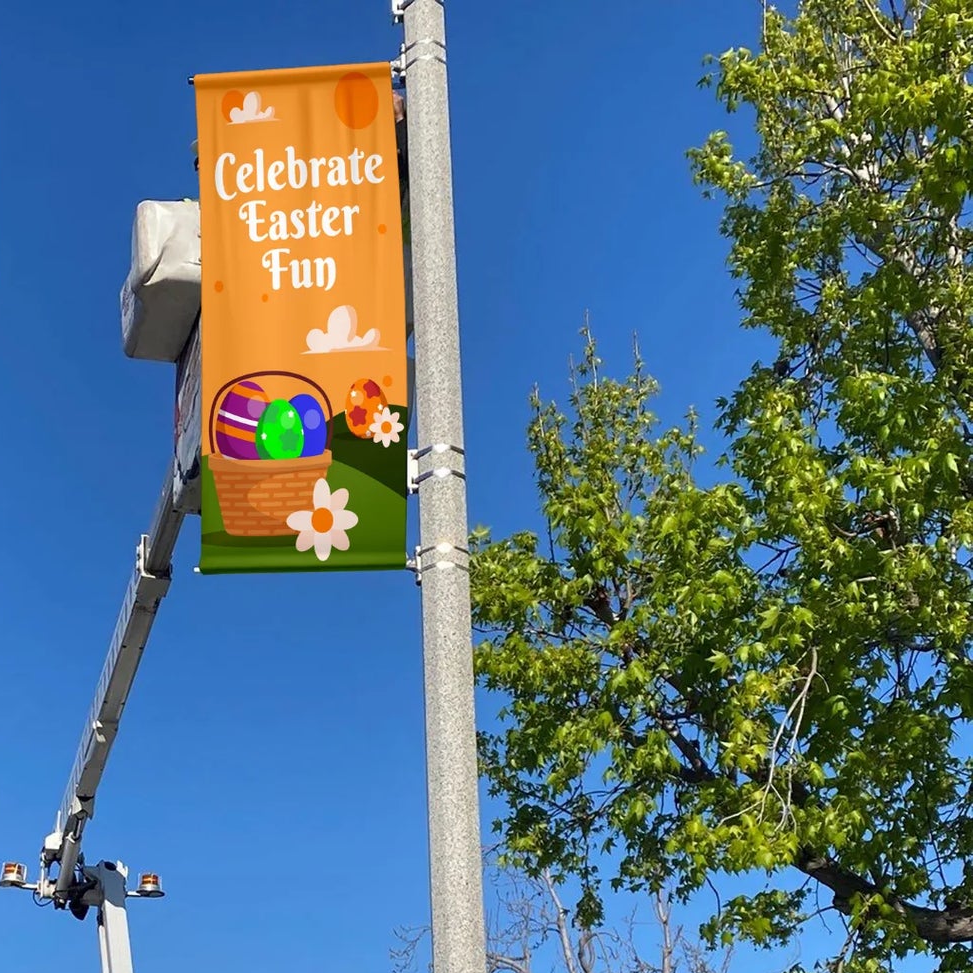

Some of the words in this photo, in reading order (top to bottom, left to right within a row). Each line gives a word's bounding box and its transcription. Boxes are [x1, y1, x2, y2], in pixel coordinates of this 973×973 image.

[214, 145, 385, 200] Celebrate
[239, 200, 360, 242] Easter
[261, 248, 337, 291] Fun
